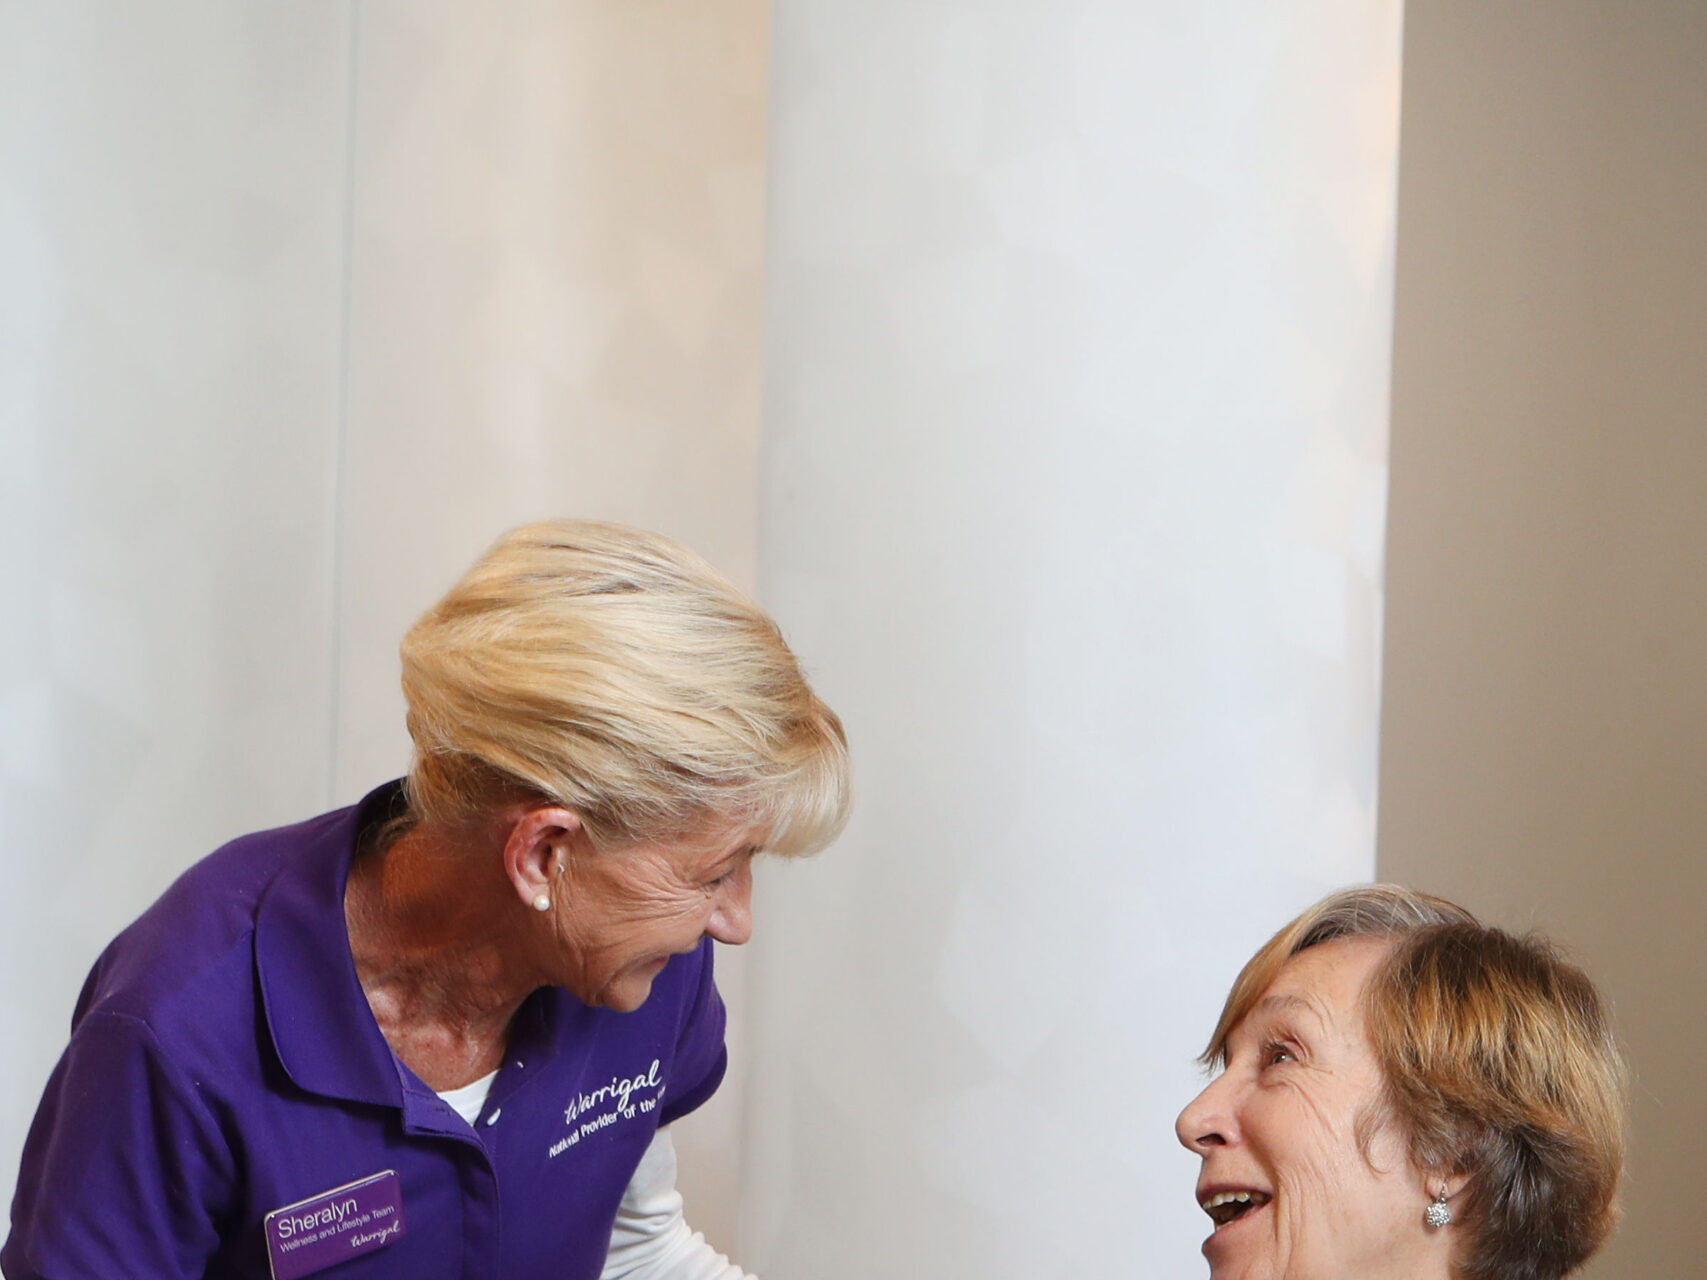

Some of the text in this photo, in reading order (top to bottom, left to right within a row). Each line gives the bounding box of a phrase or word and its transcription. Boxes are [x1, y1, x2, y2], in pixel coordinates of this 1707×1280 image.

[564, 1059, 662, 1125] Warrigal
[581, 1112, 618, 1138] Provider
[624, 1104, 636, 1119] of
[640, 1098, 656, 1113] the
[278, 1199, 358, 1239] Sheralyn
[280, 1205, 395, 1253] Wellness and Lifestyle Team
[351, 1220, 400, 1247] Warrigal
